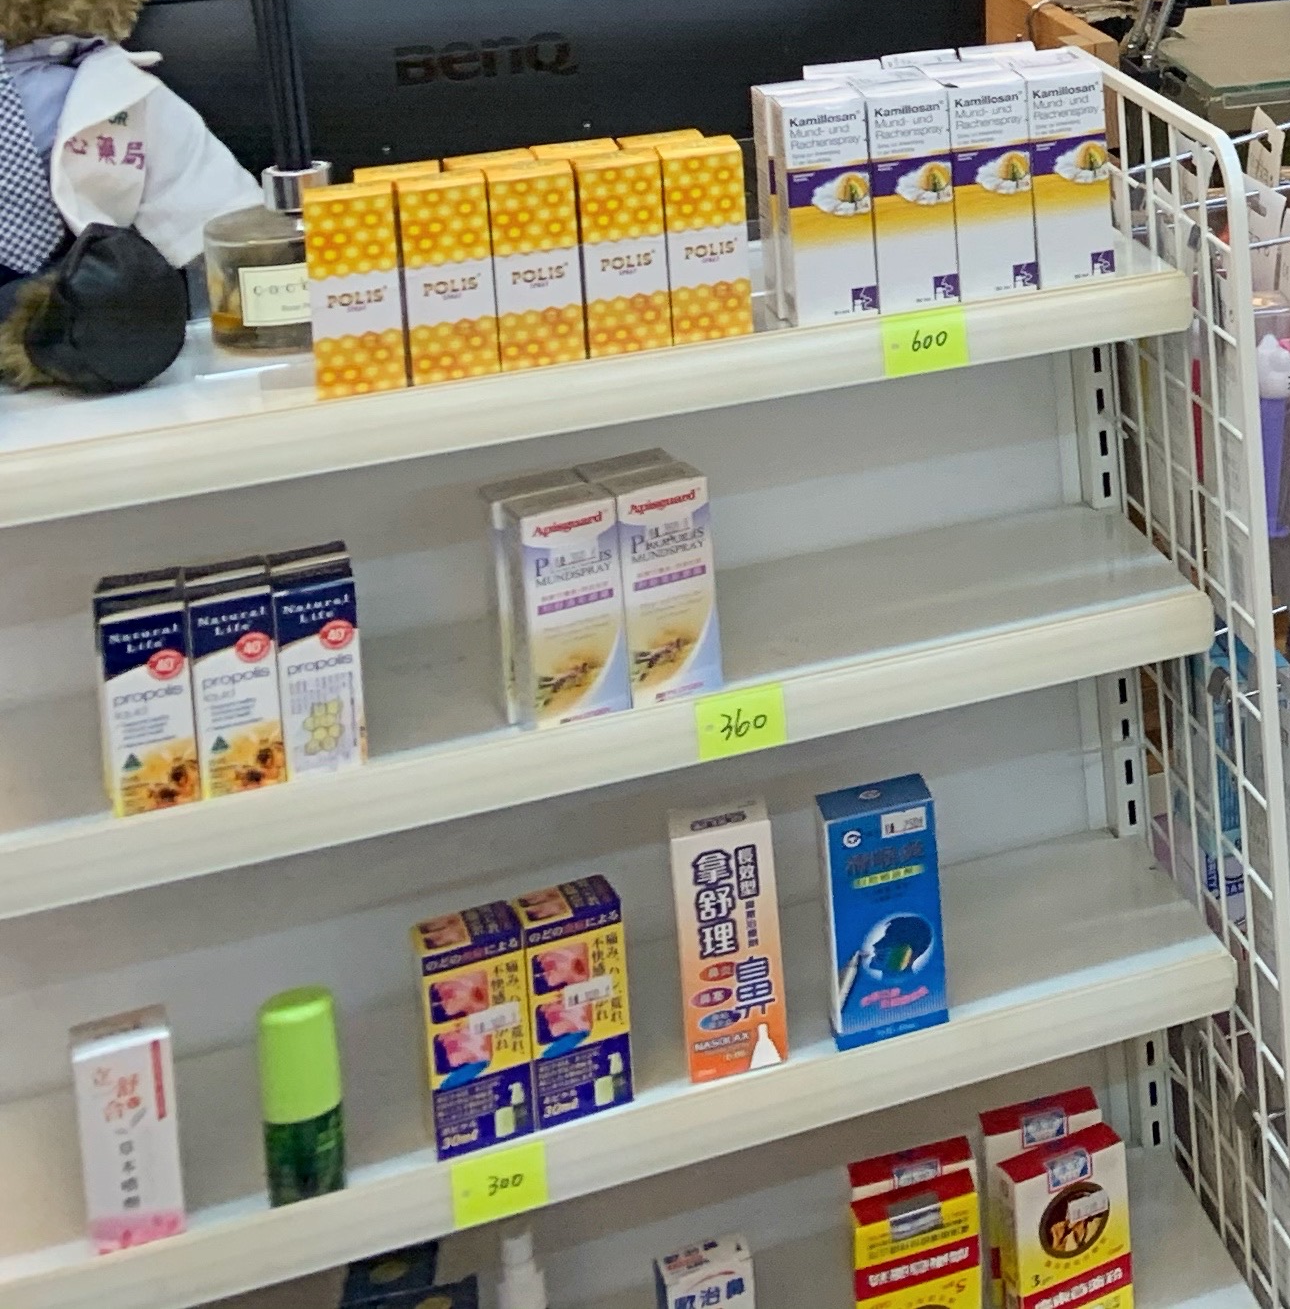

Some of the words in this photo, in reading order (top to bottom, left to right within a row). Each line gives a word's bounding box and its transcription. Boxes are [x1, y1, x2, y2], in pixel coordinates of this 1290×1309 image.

[954, 93, 1018, 108] Kamillosan
[1032, 83, 1097, 99] Kamillosan
[790, 112, 857, 128] Kamillosan
[874, 102, 940, 118] Kamillosan
[684, 240, 736, 260] POLIS
[601, 253, 653, 272] POLIS
[512, 265, 566, 285] POLIS
[424, 277, 478, 297] POLIS
[327, 289, 383, 308] POLIS
[911, 329, 948, 353] 600
[282, 593, 350, 615] Natural
[198, 606, 266, 628] Natural
[300, 610, 334, 624] Life
[108, 623, 179, 645] Natural
[215, 623, 251, 636] Life
[126, 640, 163, 654] Life
[287, 653, 353, 676] propolis
[202, 666, 270, 691] propolis
[113, 685, 184, 707] propolis
[720, 708, 768, 741] 360
[736, 846, 758, 897] 長效型
[692, 849, 738, 959] 拿舒理
[735, 956, 775, 1020] 鼻
[488, 1173, 523, 1196] 300
